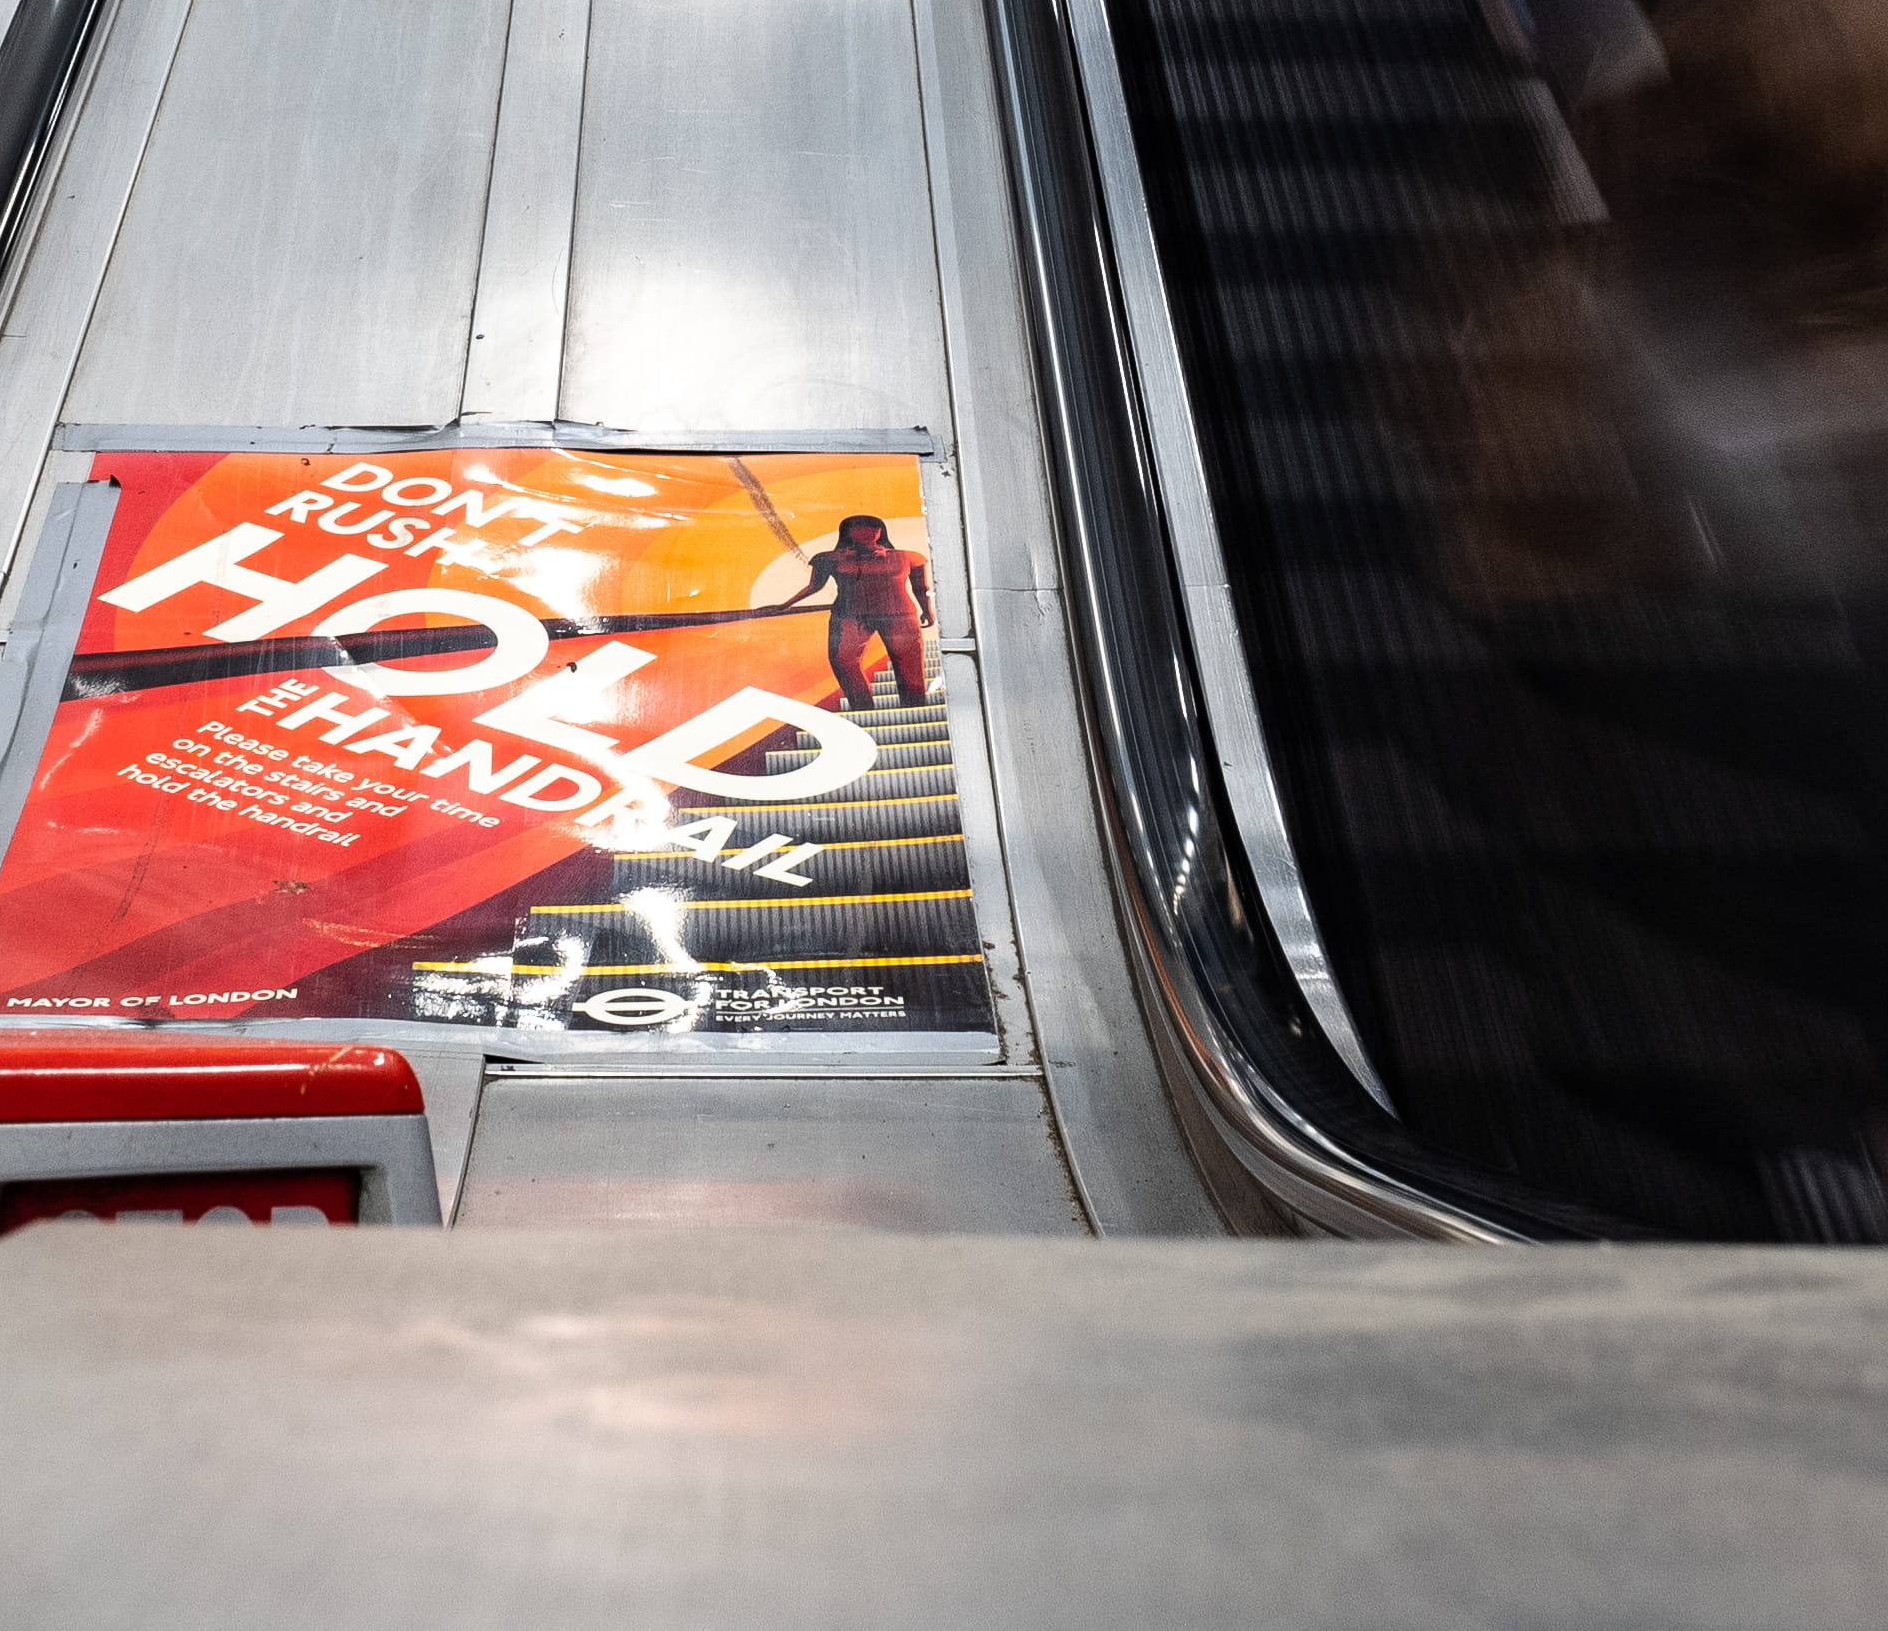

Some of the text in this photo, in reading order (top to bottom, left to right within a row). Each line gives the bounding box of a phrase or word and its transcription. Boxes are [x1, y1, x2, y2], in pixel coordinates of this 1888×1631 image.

[97, 521, 877, 801] HOLD
[237, 677, 320, 718] THE
[116, 763, 362, 848] hold the handrail
[144, 751, 354, 825] escalators and
[172, 737, 409, 819] on the stairs and
[196, 719, 502, 829] Please take your time
[276, 690, 826, 889] HANDRAIL
[7, 988, 299, 1008] MAYOR OF LONDON
[715, 997, 905, 1011] FOR LONDON
[715, 1010, 907, 1023] EVERY JOURNEY MATTERS
[717, 986, 885, 1000] TRANSPORT
